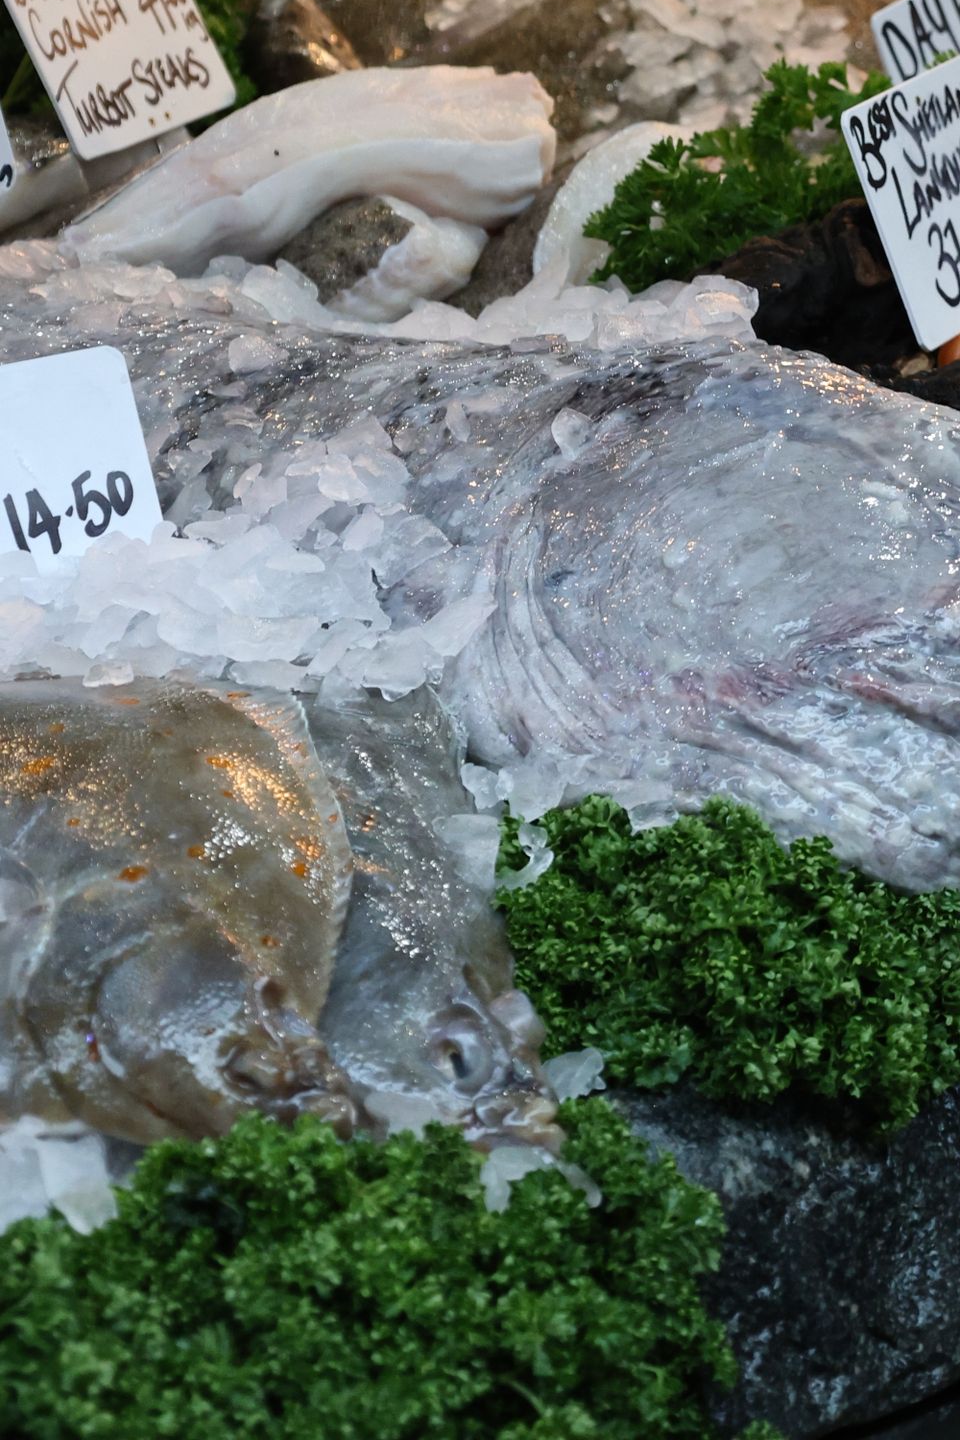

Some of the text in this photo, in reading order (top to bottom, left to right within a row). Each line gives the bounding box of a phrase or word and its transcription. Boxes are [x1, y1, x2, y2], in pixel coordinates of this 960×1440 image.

[55, 46, 211, 138] TURBOT STEAKS
[850, 92, 897, 192] BEST
[2, 469, 134, 555] 14.50
